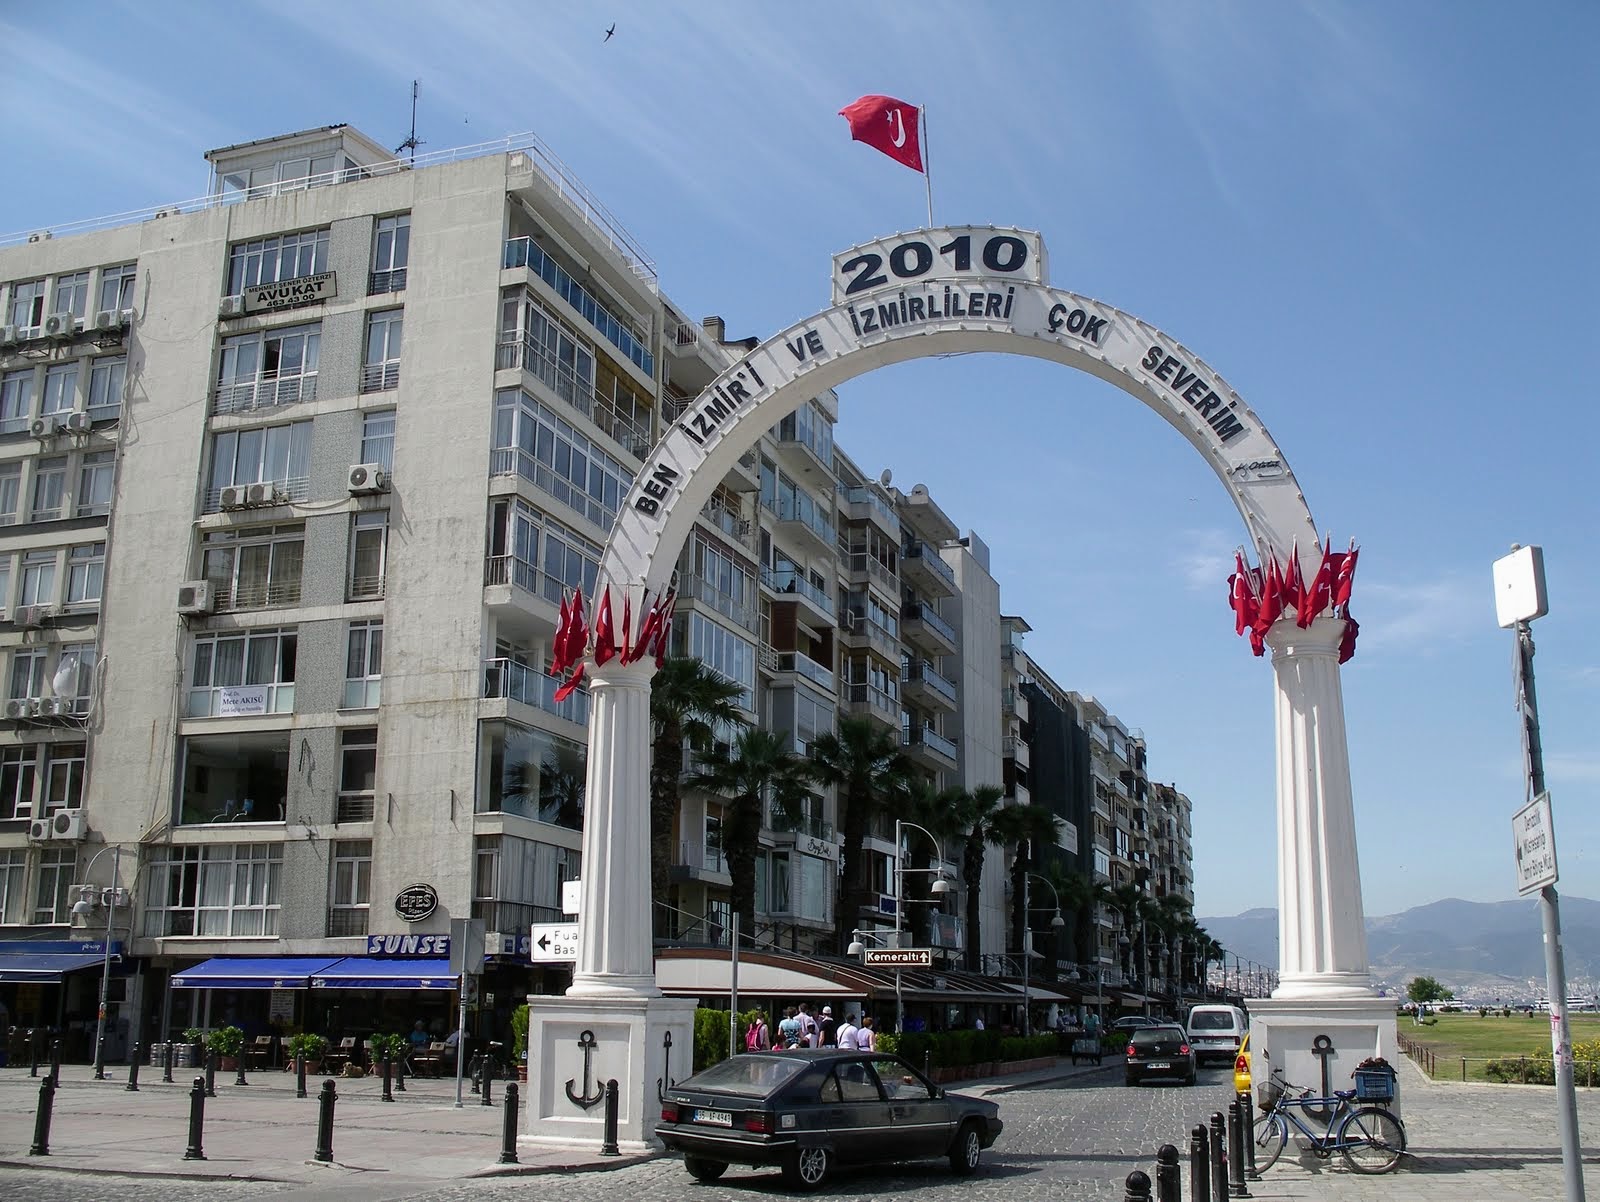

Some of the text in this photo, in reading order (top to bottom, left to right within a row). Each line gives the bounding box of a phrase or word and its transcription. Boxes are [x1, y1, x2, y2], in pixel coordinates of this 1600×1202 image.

[841, 235, 1027, 295] 2010
[248, 284, 277, 293] MEHMET
[257, 281, 324, 302] AVUKAT
[266, 298, 285, 307] 463
[302, 293, 315, 301] 00
[634, 286, 1244, 516] BEN İZMİR'İ VE İZMİRLİLERİ ÇOK SEVERİM
[400, 894, 432, 908] EFES
[369, 935, 451, 954] SUNSE
[867, 951, 919, 961] Kemeraltı
